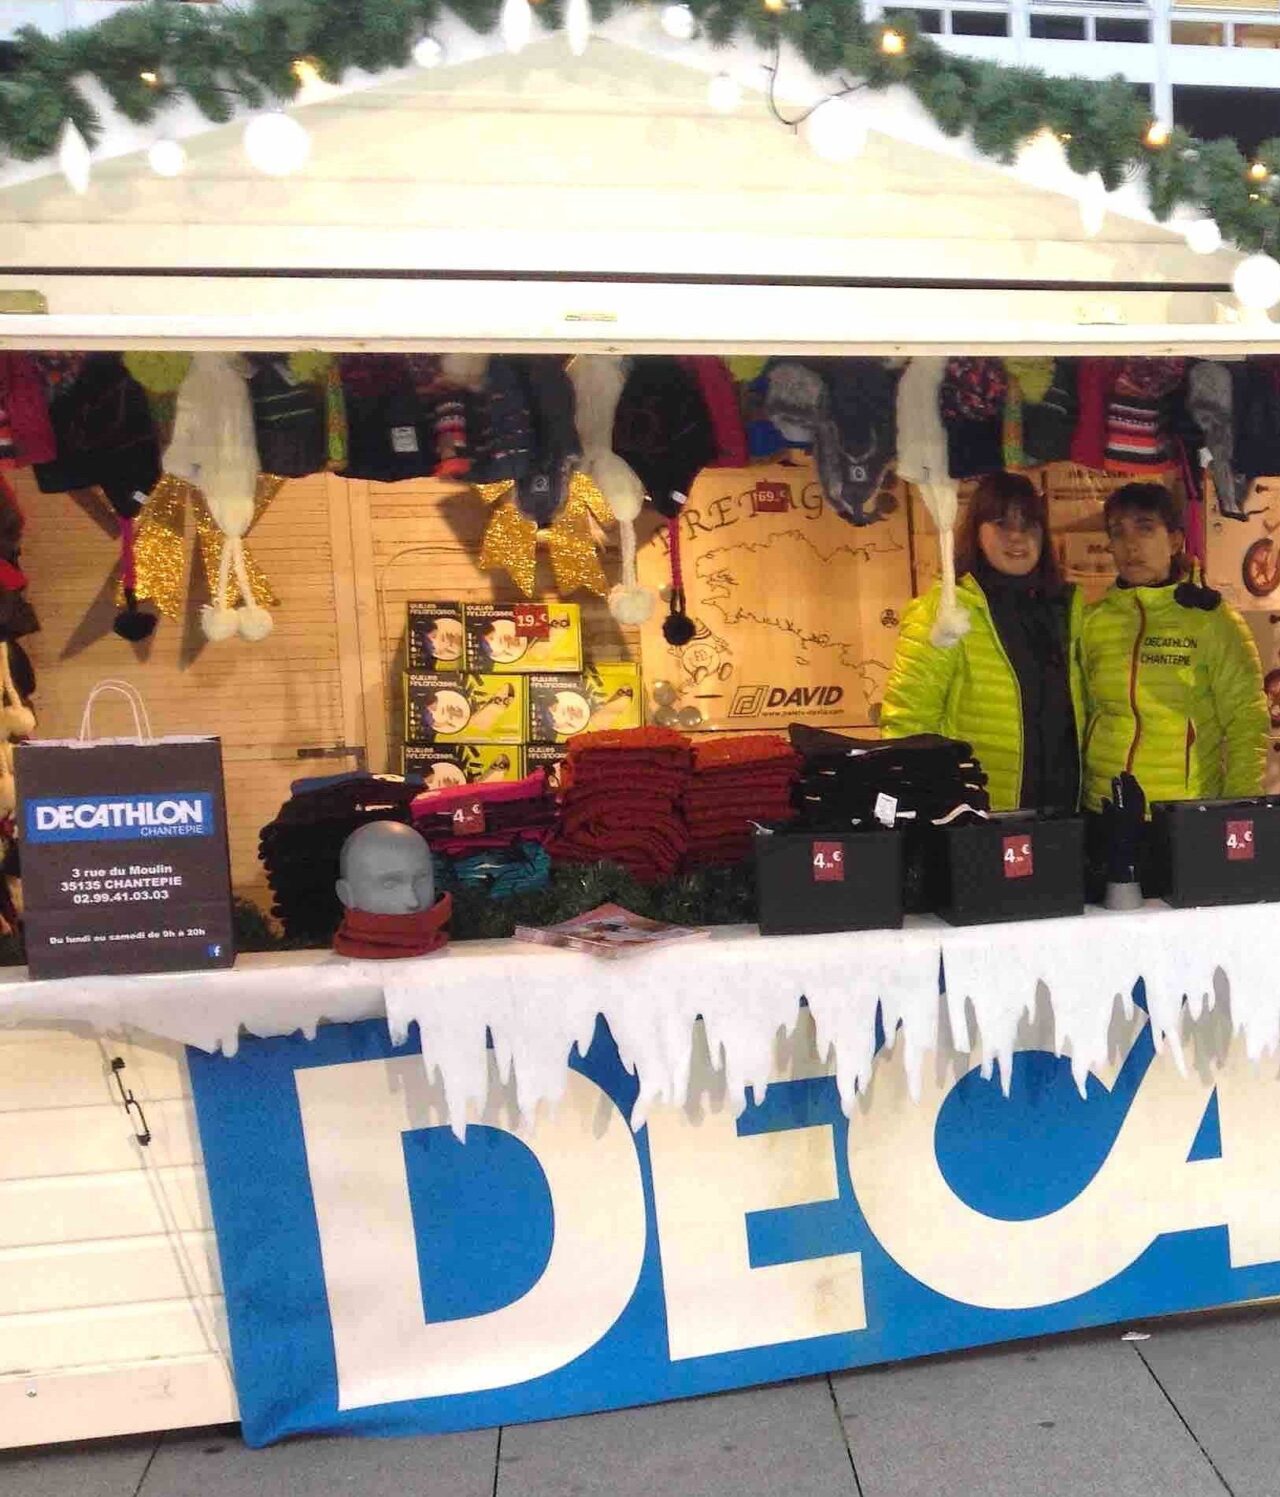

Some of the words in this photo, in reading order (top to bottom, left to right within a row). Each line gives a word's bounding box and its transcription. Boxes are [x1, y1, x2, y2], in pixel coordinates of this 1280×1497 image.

[1144, 636, 1198, 649] DECATHLON
[767, 685, 844, 708] DAVID
[36, 800, 204, 831] DECATHLON
[140, 824, 204, 837] CHANTEPIE
[71, 868, 81, 878] 3
[84, 868, 106, 877] rue
[109, 866, 126, 876] du
[129, 864, 173, 875] Moulin
[60, 880, 101, 892] 35135
[104, 876, 183, 889] CHANTEPIE
[73, 890, 169, 904] 02.99.41.03.03
[49, 935, 64, 945] Du
[65, 934, 91, 944] lundi
[108, 931, 146, 941] samedi
[147, 930, 160, 939] de
[187, 927, 206, 937] 20h
